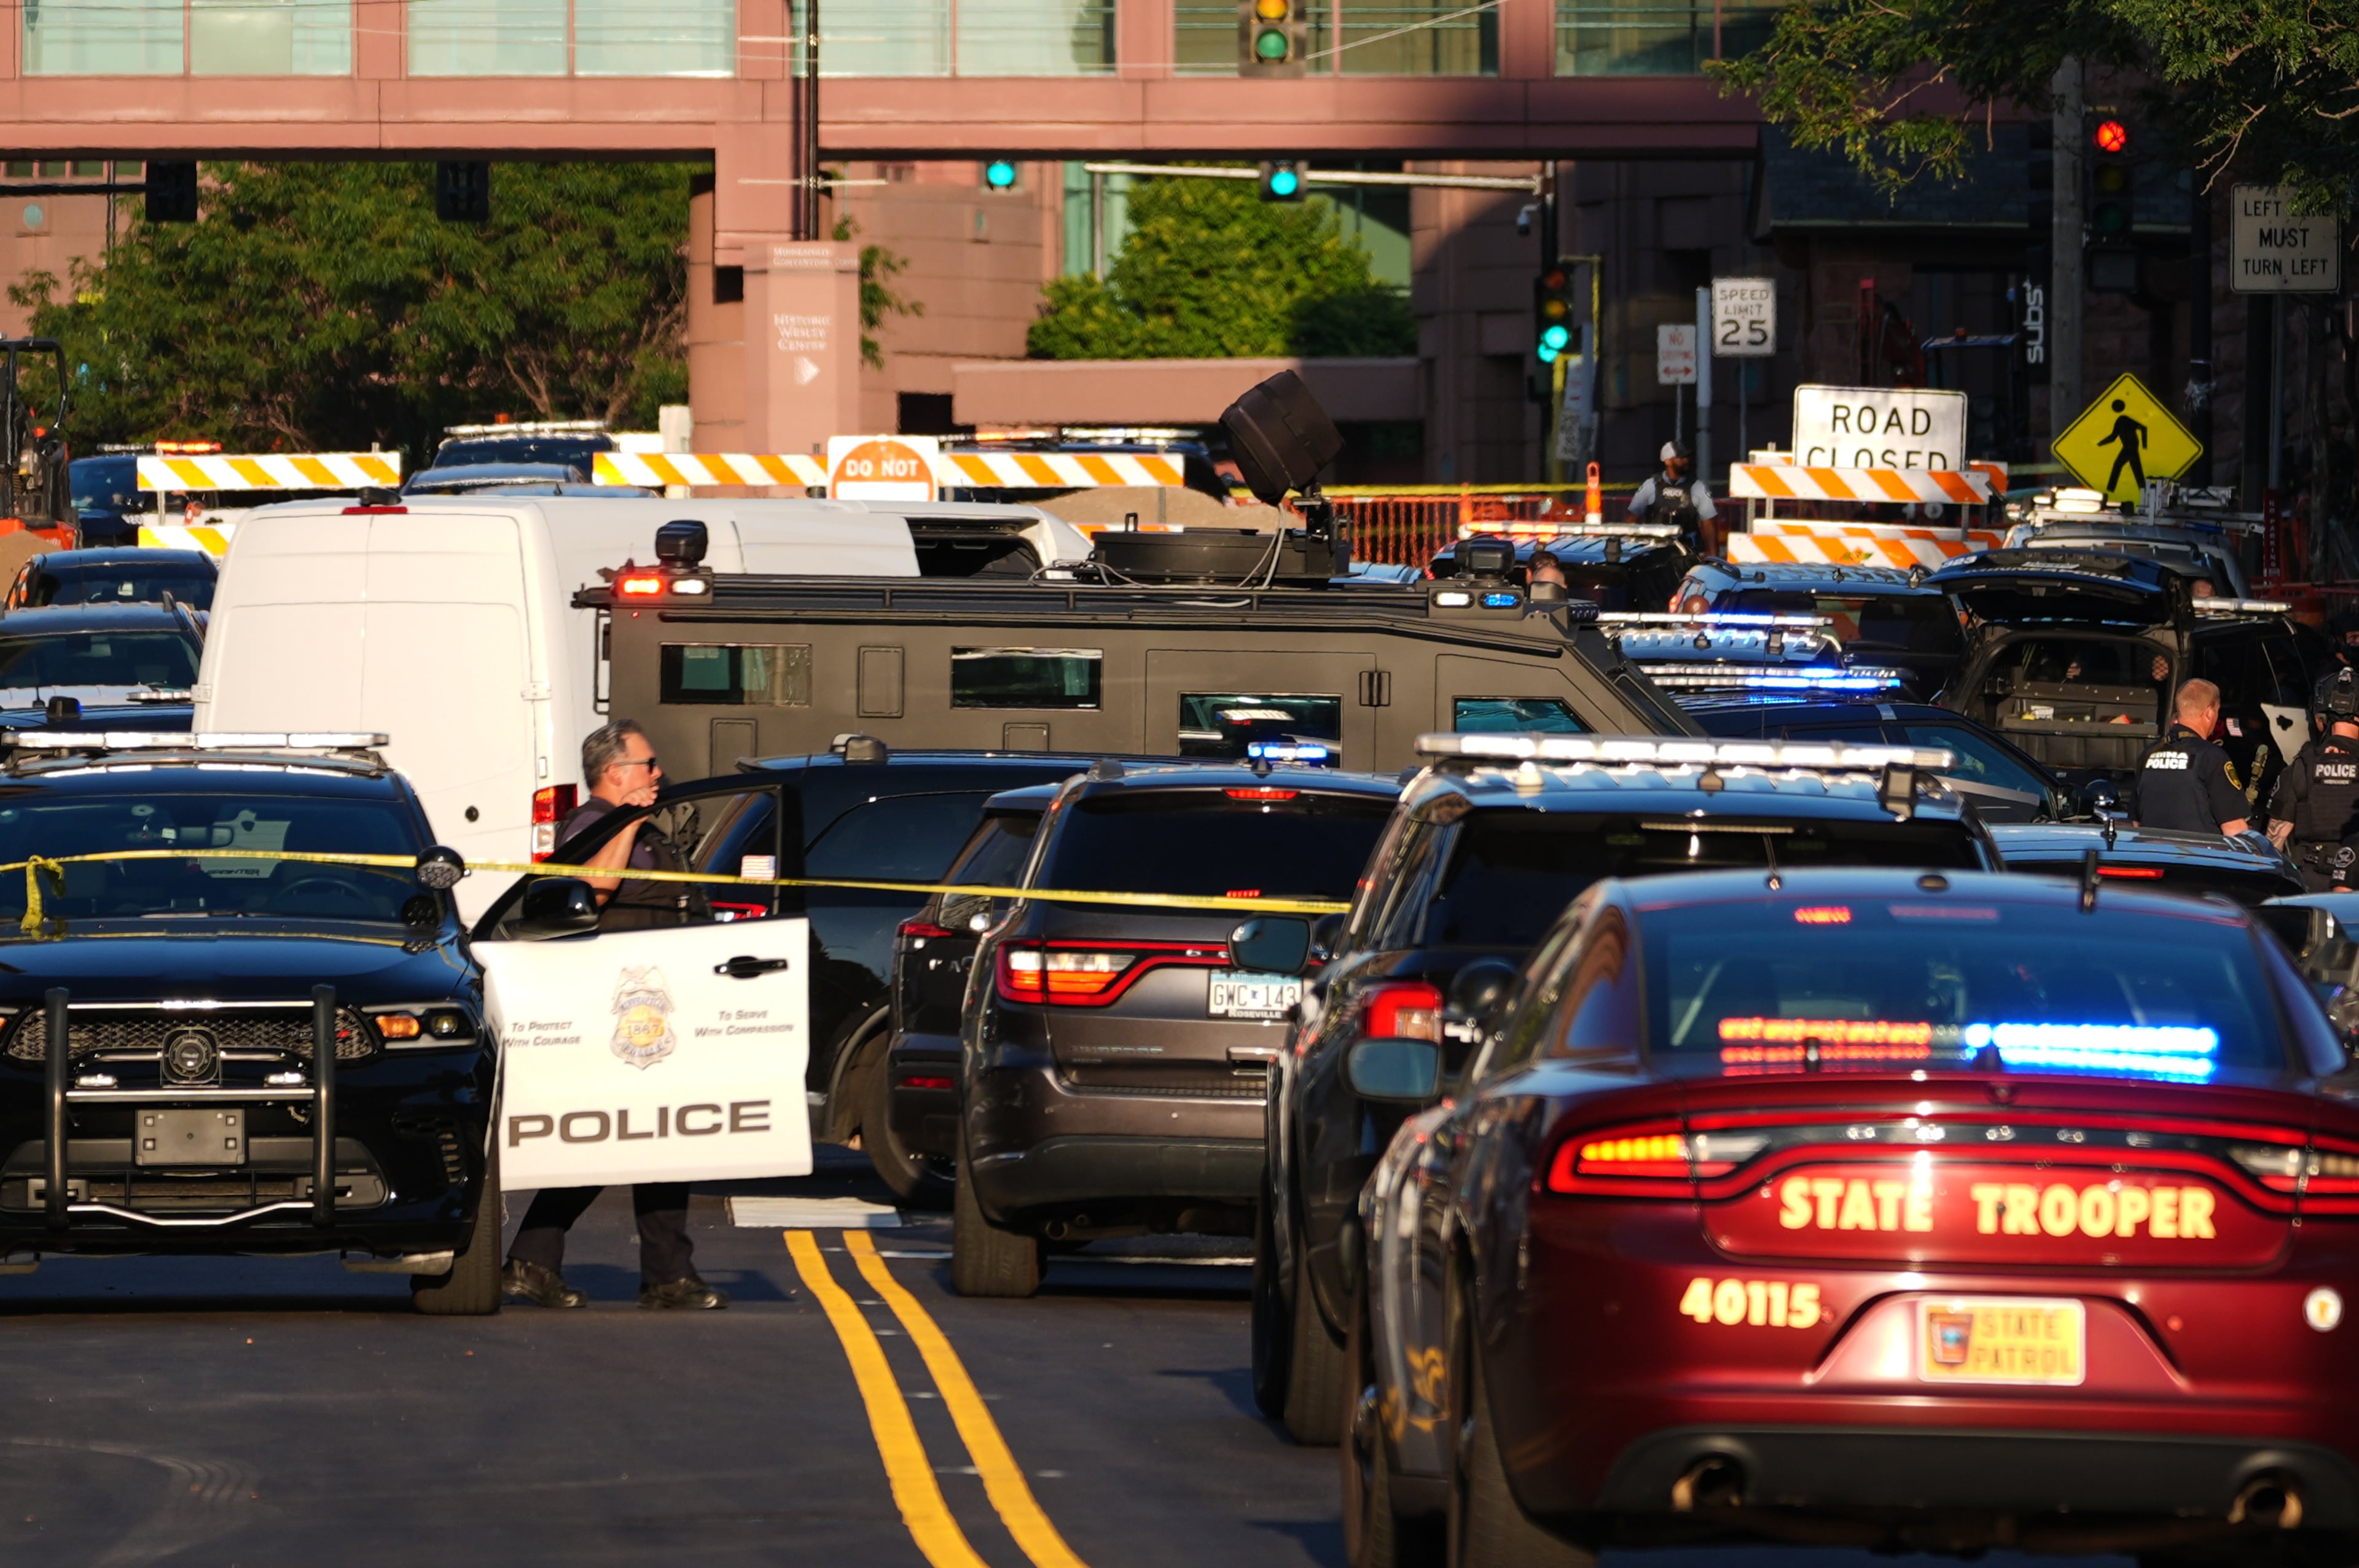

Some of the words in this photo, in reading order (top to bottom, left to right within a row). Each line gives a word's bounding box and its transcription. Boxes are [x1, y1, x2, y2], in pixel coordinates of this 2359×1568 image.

[2244, 201, 2281, 216] LEFT
[2259, 228, 2310, 248] MUST
[2243, 259, 2282, 275] TURN
[2291, 259, 2328, 275] LEFT
[1719, 288, 1769, 301] SPEED
[1724, 304, 1763, 316] LIMIT
[1669, 332, 1684, 346] NO
[1721, 319, 1768, 346] 25
[1832, 405, 1932, 437] ROAD
[845, 459, 873, 477] DO
[882, 459, 920, 477] NOT
[1807, 447, 1948, 470] CLOSED
[2145, 759, 2189, 770] POLICE
[2315, 764, 2357, 778] POLICE
[1214, 984, 1248, 1006] GWC
[1262, 986, 1296, 1008] 143
[1228, 1010, 1282, 1018] ROSEVILLE
[508, 1099, 770, 1147] POLICE
[1779, 1177, 1934, 1232] STATE
[1971, 1183, 2216, 1239] TROOPER
[1680, 1277, 1821, 1329] 40115
[1979, 1310, 2060, 1340] STATE
[1974, 1348, 2075, 1375] PATROL
